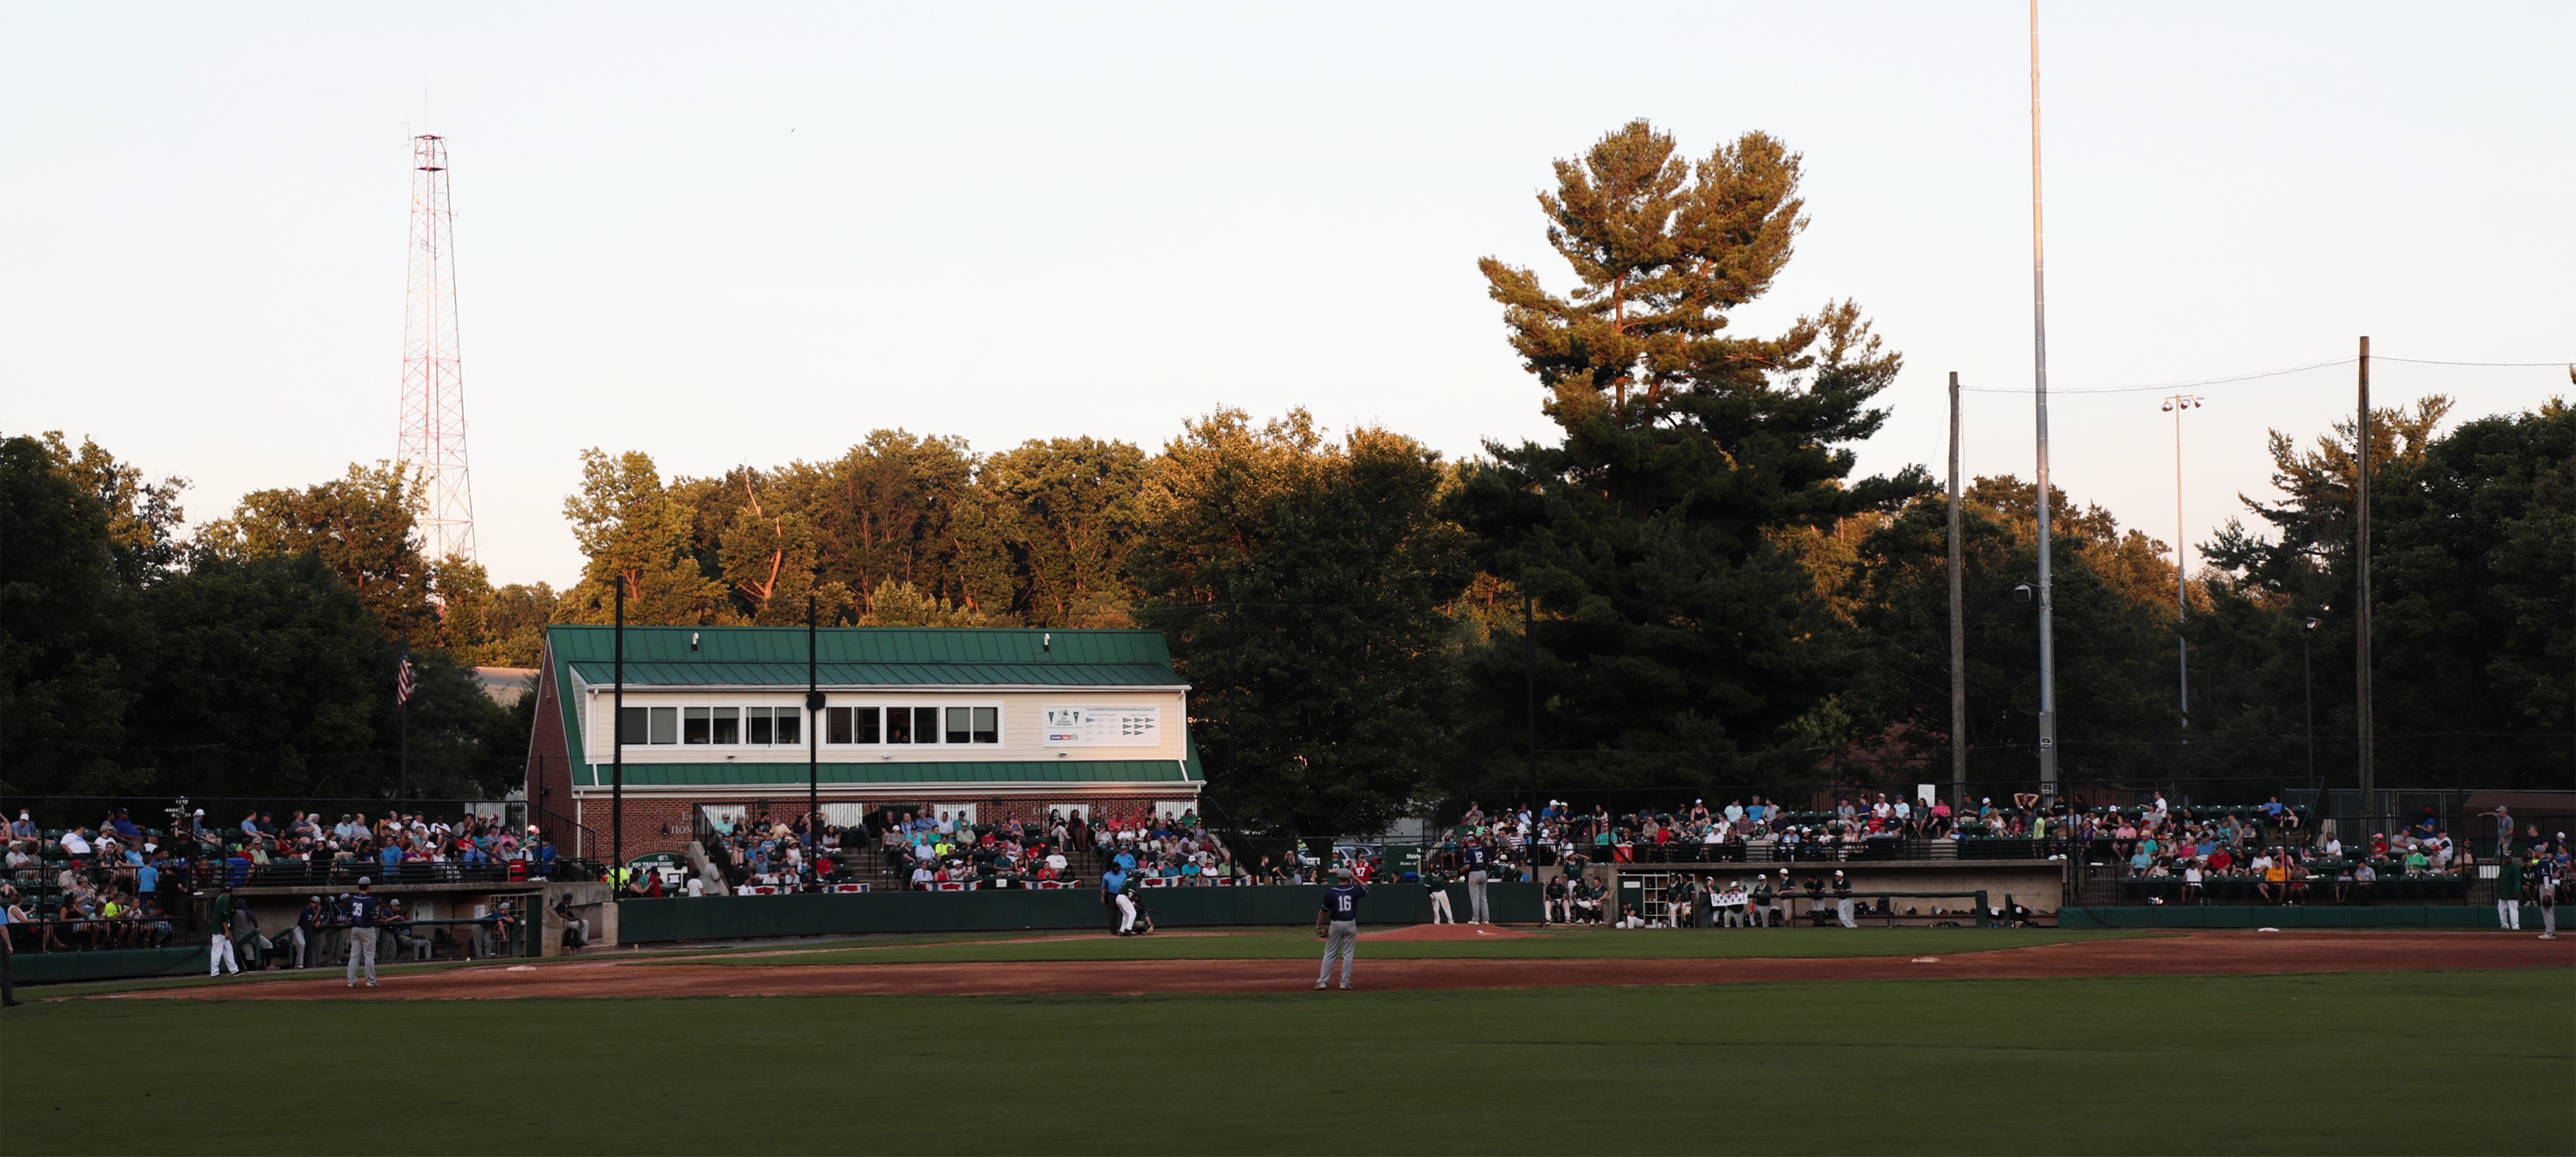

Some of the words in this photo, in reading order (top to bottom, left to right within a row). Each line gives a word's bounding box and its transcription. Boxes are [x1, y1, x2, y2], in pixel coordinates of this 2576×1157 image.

[1475, 851, 1483, 863] 12
[1355, 867, 1366, 877] 97
[352, 902, 363, 917] 39
[1338, 895, 1351, 912] 16
